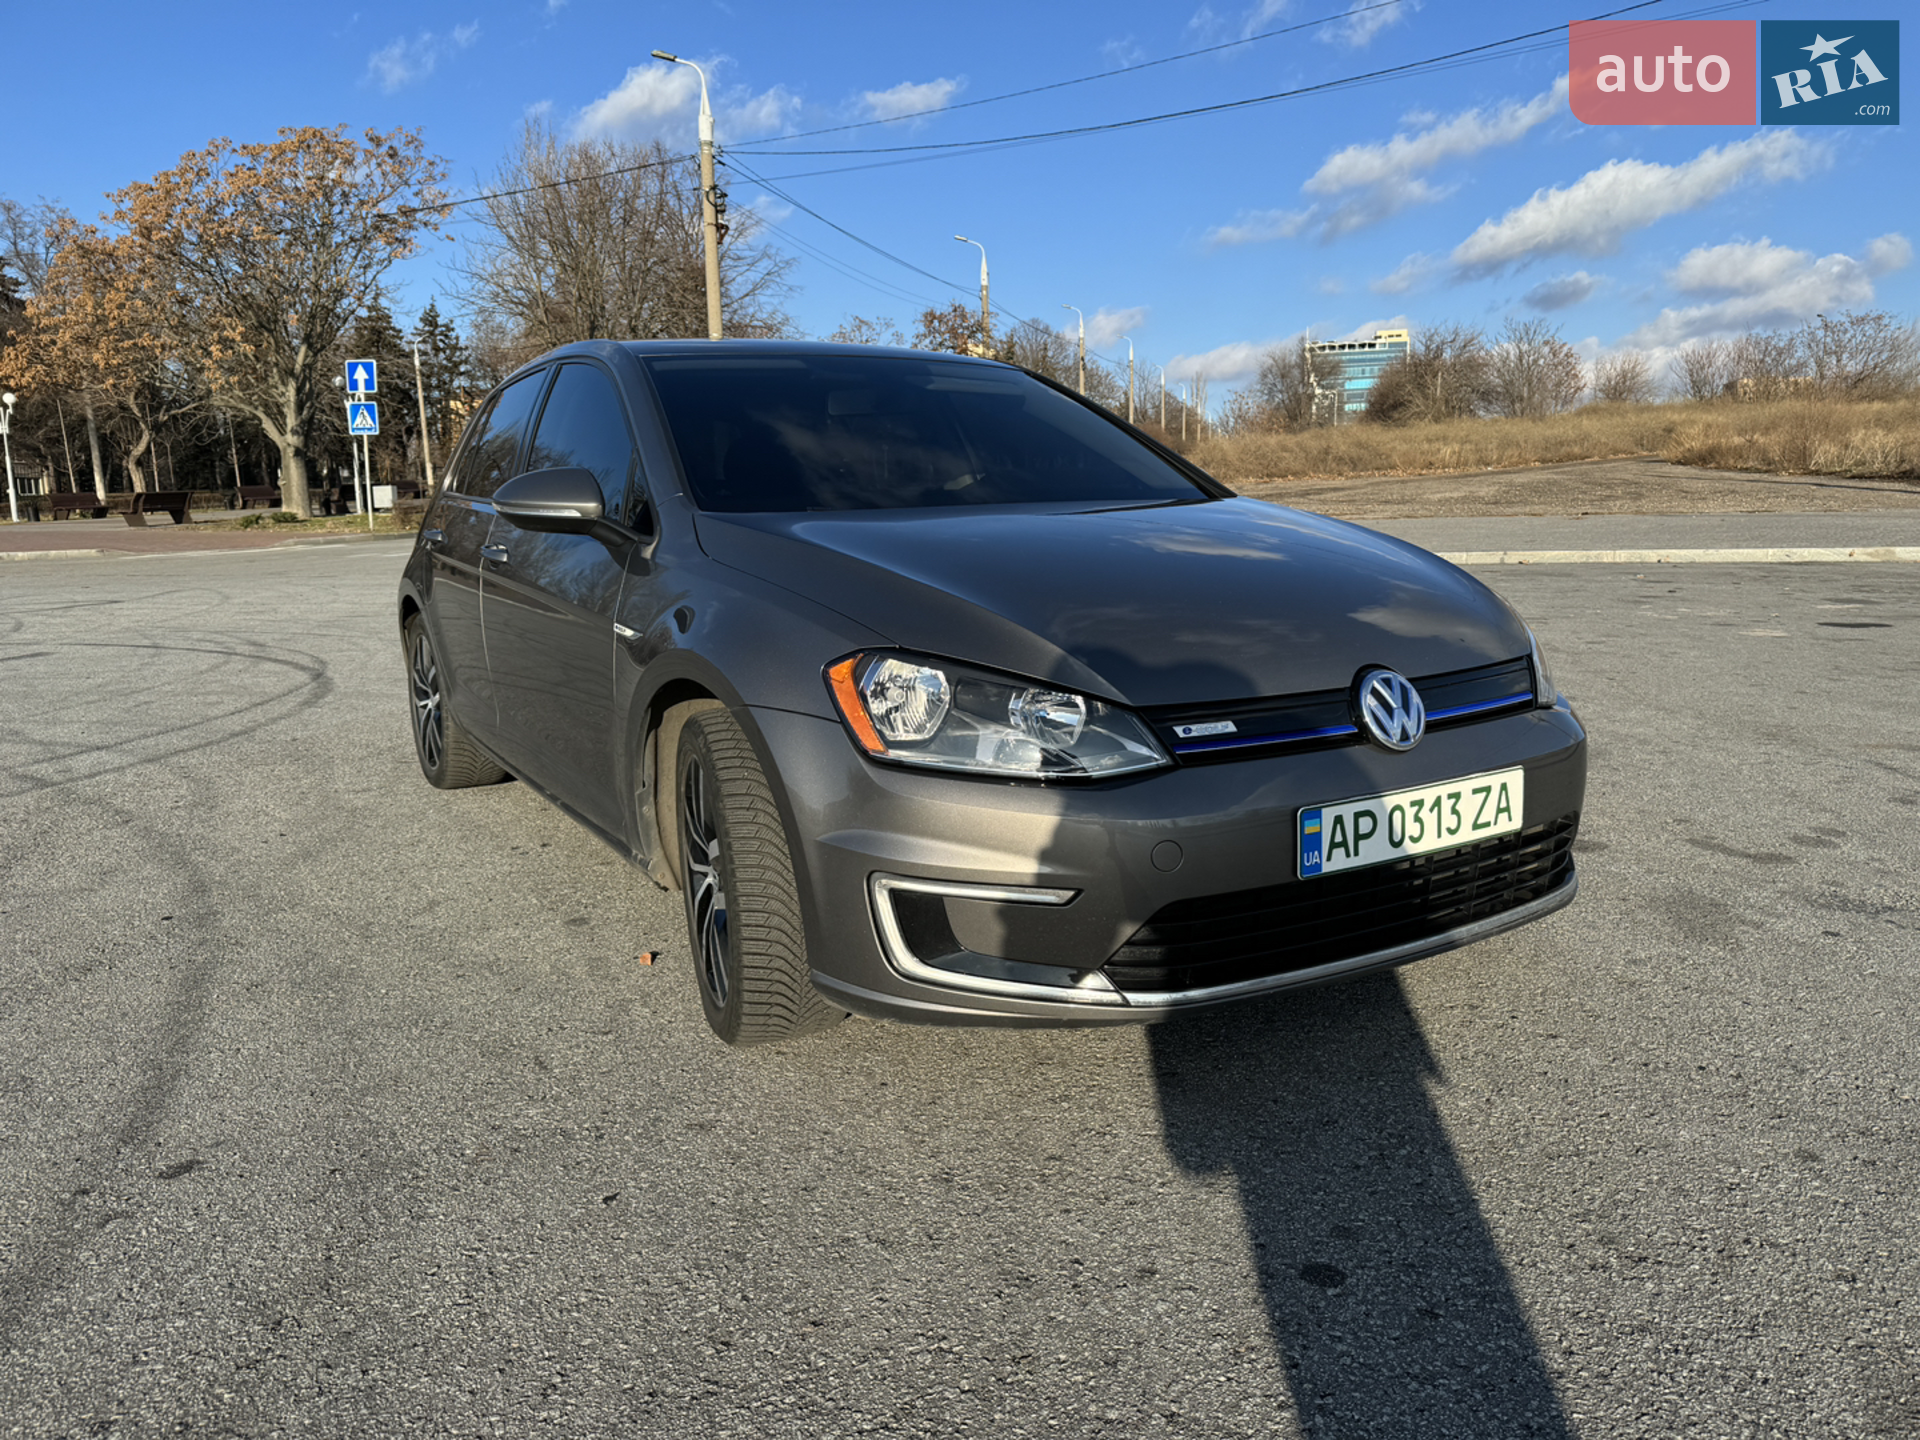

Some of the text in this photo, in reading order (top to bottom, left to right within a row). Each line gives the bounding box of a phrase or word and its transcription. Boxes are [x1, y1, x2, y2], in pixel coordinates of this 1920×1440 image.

[1326, 782, 1513, 862] AP 0313 ZA
[1303, 850, 1321, 867] UA
